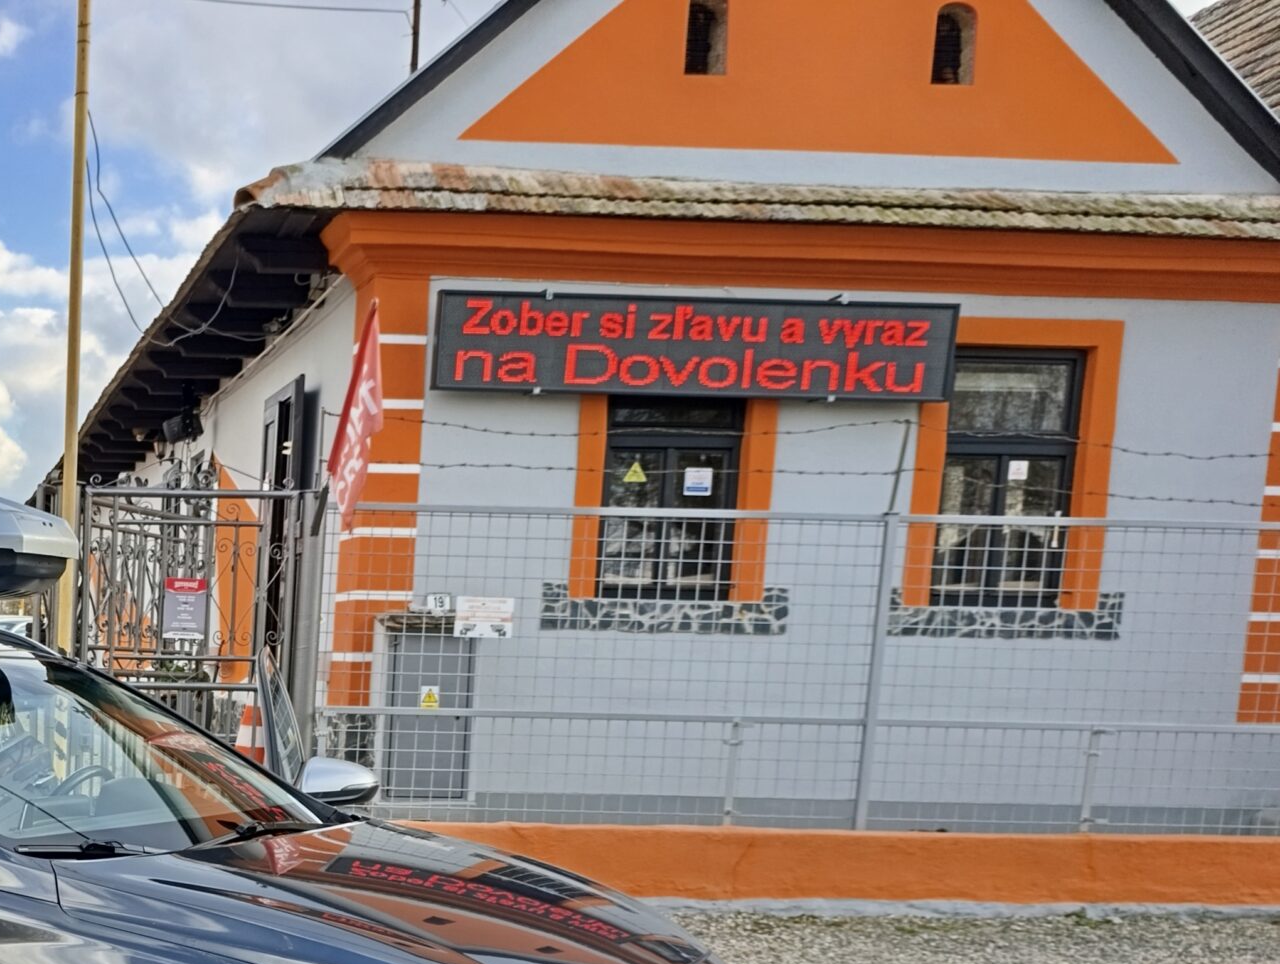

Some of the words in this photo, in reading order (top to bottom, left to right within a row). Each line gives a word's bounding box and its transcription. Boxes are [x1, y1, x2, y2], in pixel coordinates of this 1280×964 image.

[462, 298, 590, 337] Zober
[600, 303, 638, 339] si
[648, 304, 769, 342] zľavu
[780, 317, 805, 343] a
[818, 318, 931, 349] vyraz
[454, 350, 537, 383] na
[563, 343, 926, 393] Dovolenku
[433, 596, 445, 609] 19
